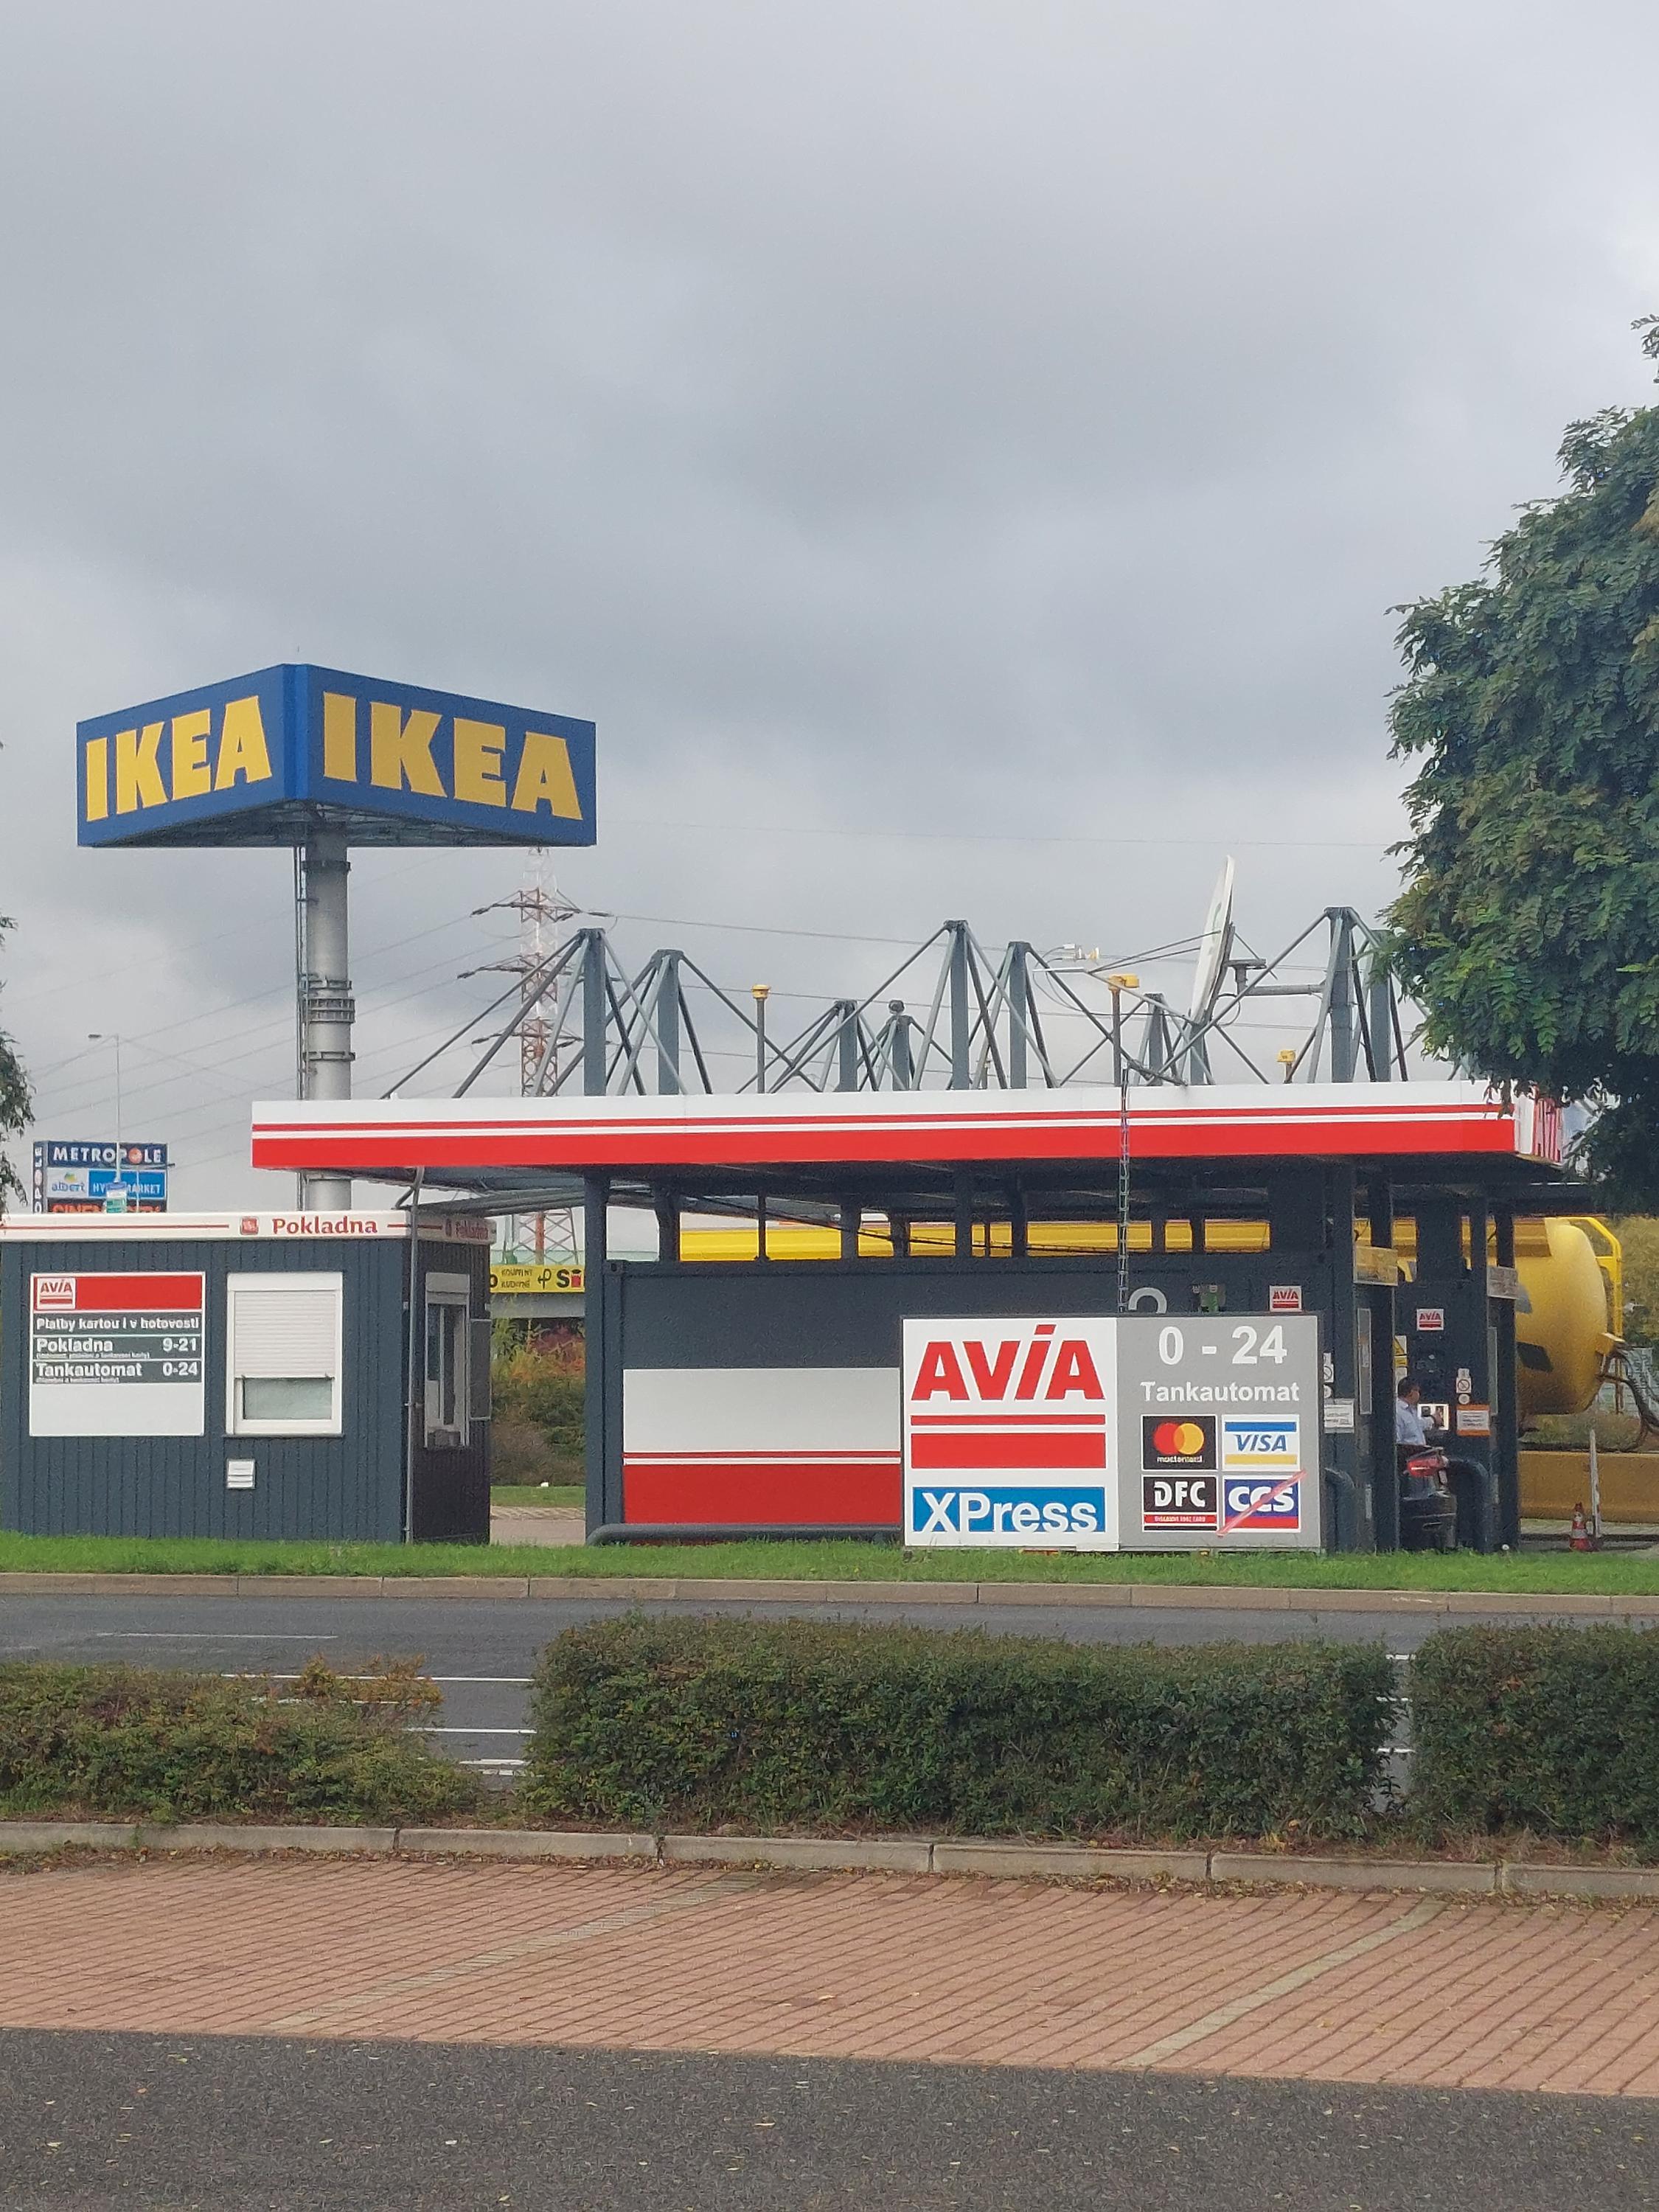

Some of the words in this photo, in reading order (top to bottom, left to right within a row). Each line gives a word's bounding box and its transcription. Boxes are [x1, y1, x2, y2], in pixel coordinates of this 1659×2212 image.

[86, 695, 272, 821] IKEA
[324, 692, 583, 820] IKEA
[53, 1147, 161, 1165] METROPOLE
[272, 1216, 378, 1234] Pokladna
[41, 1279, 72, 1293] AVIA
[1273, 1290, 1298, 1300] AVIA
[1419, 1310, 1441, 1320] AVIA
[36, 1318, 75, 1332] Platby
[79, 1318, 119, 1329] kartou
[129, 1320, 137, 1329] v
[141, 1317, 199, 1329] hotovosti
[36, 1338, 113, 1352] Pokladna
[162, 1338, 197, 1352] 9-21
[1158, 1326, 1183, 1365] 0
[1231, 1325, 1287, 1364] 24
[36, 1363, 142, 1377] Tankautomat
[162, 1362, 198, 1376] 0-24
[911, 1324, 1105, 1400] AVIA
[1141, 1381, 1299, 1402] Tankautomat
[1234, 1434, 1287, 1452] VISA
[1154, 1481, 1206, 1507] DFC
[1228, 1486, 1295, 1512] CCS
[922, 1492, 1098, 1533] XPress
